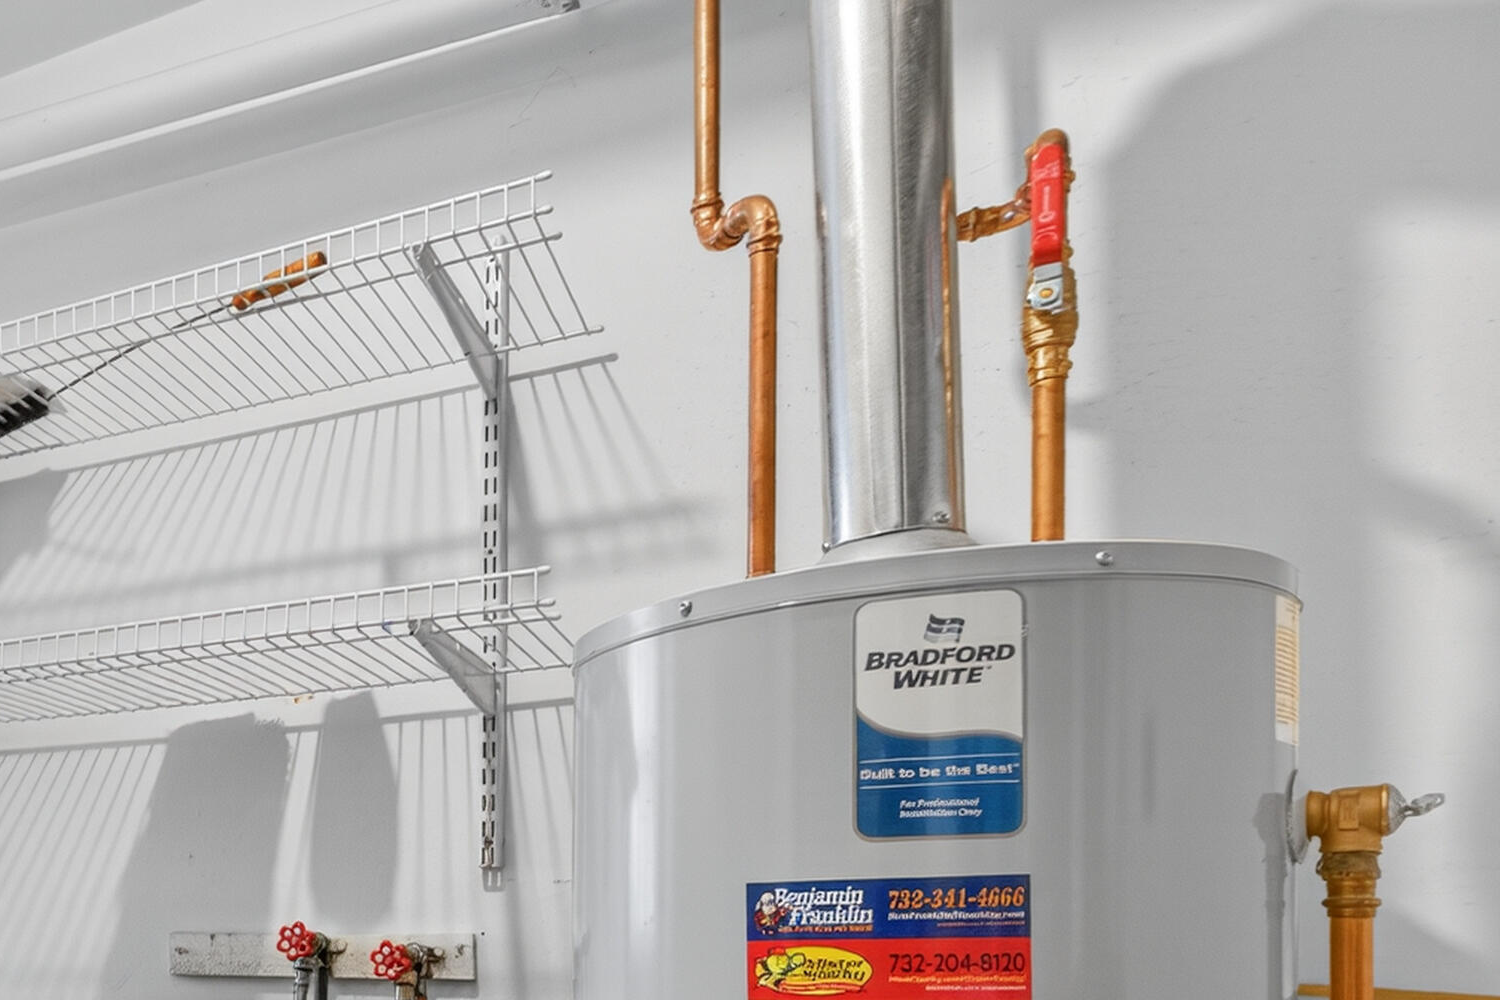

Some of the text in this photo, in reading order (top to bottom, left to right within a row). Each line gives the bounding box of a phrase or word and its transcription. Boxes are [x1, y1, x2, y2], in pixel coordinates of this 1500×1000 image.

[865, 644, 1015, 671] BRADFORD
[893, 666, 984, 690] WHITE
[899, 767, 916, 779] to
[919, 766, 941, 778] be
[774, 886, 864, 909] Benjamin
[888, 886, 1025, 910] 732-341-4666
[789, 905, 874, 927] Franklin
[888, 952, 1026, 973] 732-204-8120
